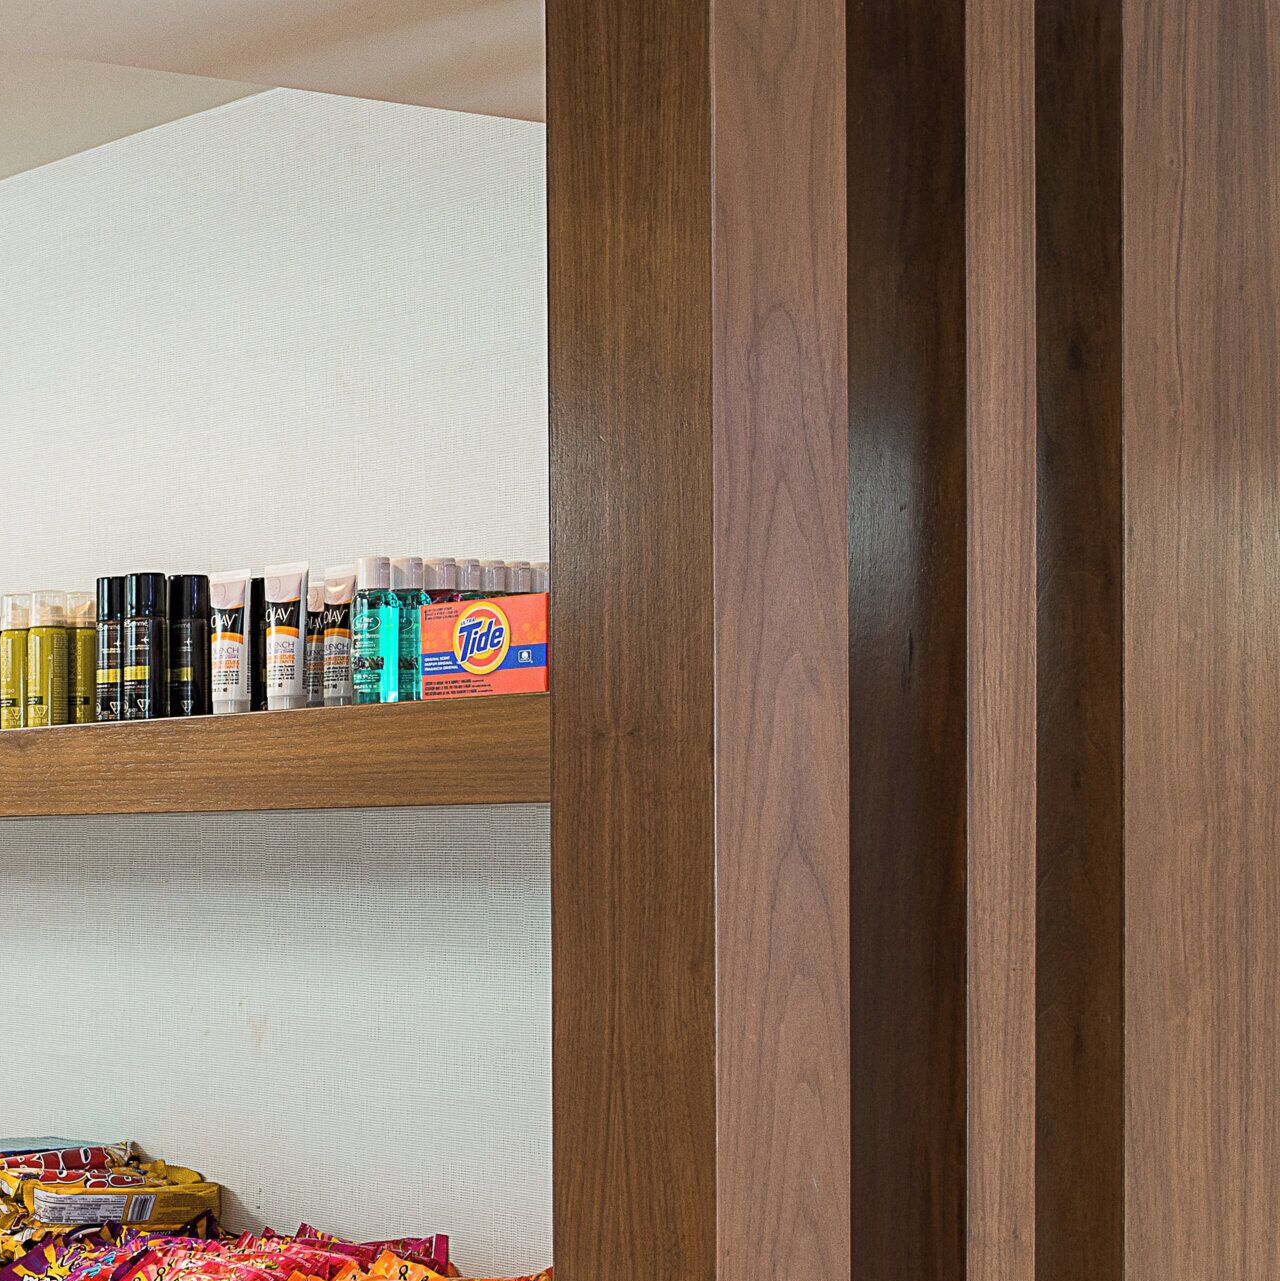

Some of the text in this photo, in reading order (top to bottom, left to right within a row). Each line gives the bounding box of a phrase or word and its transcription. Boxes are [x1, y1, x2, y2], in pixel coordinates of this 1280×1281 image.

[211, 614, 236, 629] OLAY
[265, 607, 292, 623] OLAY
[323, 609, 346, 624] OLAY
[458, 617, 505, 663] Tide
